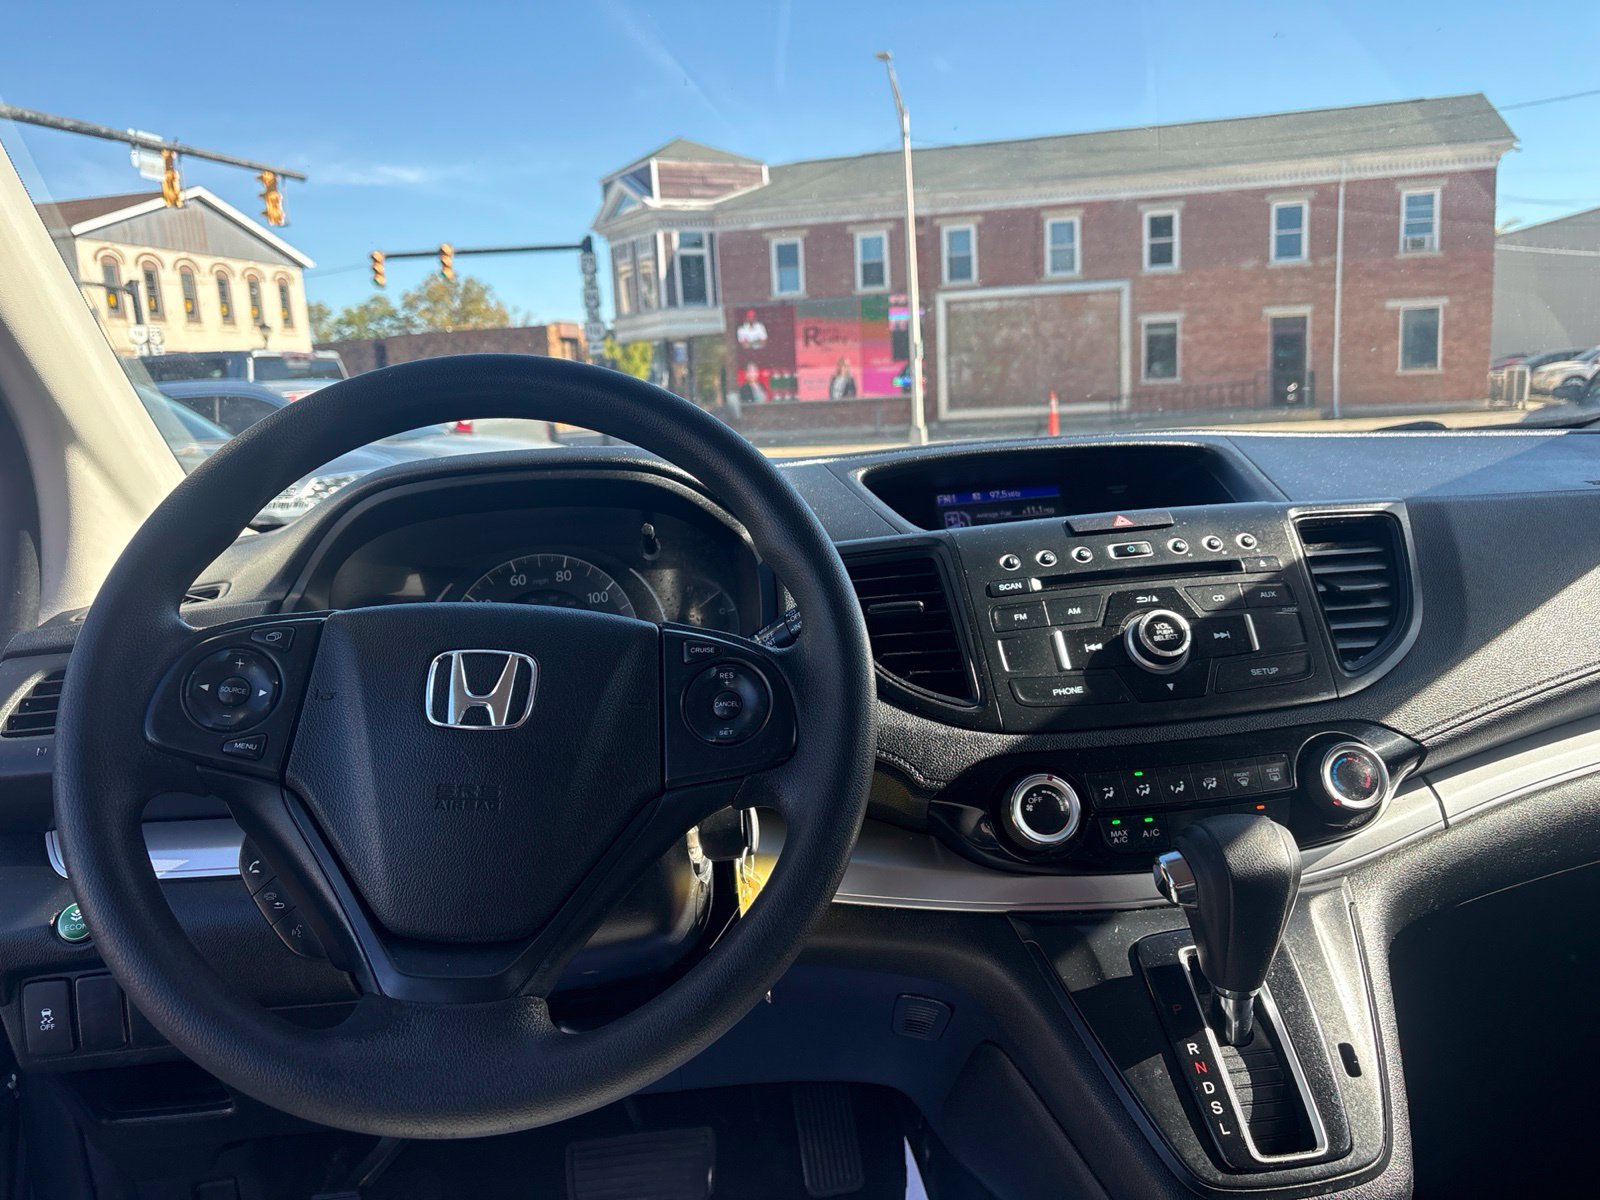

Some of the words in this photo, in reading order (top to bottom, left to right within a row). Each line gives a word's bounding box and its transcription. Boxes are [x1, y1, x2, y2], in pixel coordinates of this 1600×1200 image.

[509, 574, 527, 587] 60
[555, 570, 572, 582] 80
[998, 581, 1023, 592] SCAN
[586, 591, 609, 604] 100
[1212, 594, 1225, 602] CD
[1260, 590, 1277, 599] AUX
[1067, 606, 1081, 616] AM
[1013, 611, 1028, 622] FM
[1153, 633, 1179, 642] SELECT
[690, 646, 715, 654] CRUISE
[719, 671, 734, 679] RES
[1250, 665, 1279, 677] SETUP
[218, 685, 248, 696] SOURCE
[1052, 684, 1083, 697] PHONE
[714, 700, 739, 709] CANCEL
[233, 742, 258, 751] MENU
[1027, 796, 1043, 804] OFF
[1110, 829, 1128, 838] MAX
[1142, 828, 1160, 838] A/C
[1113, 836, 1128, 844] A/C
[39, 1022, 56, 1031] OFF
[1186, 1043, 1199, 1055] R
[1194, 1062, 1207, 1074] N
[1202, 1081, 1215, 1094] D
[1211, 1101, 1223, 1115] S
[1219, 1123, 1231, 1136] L
